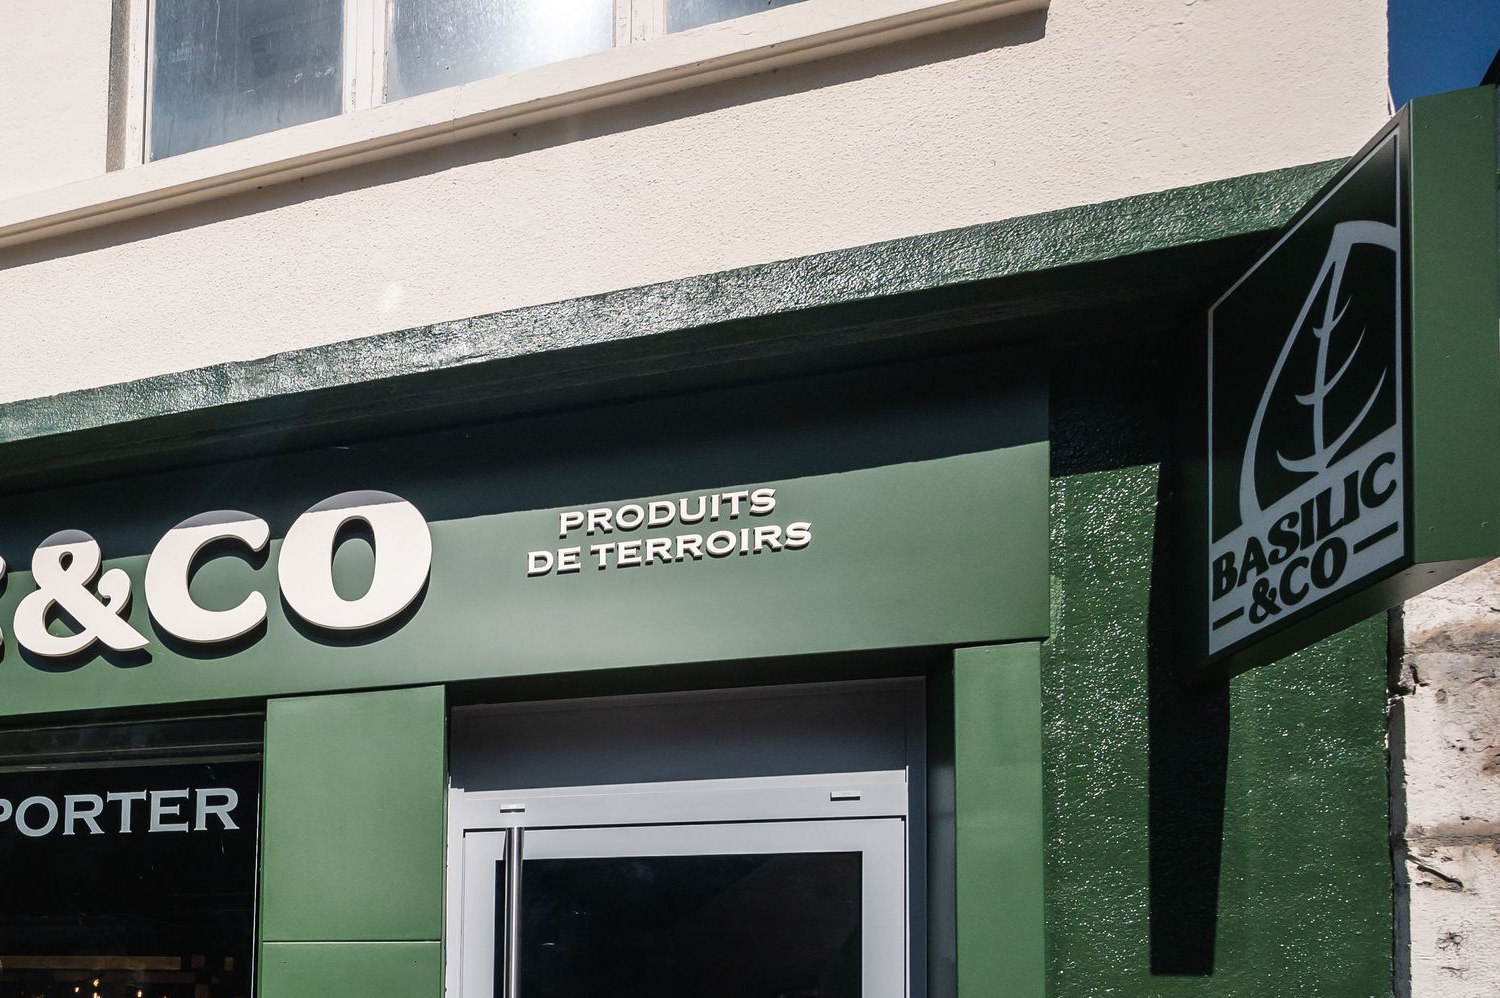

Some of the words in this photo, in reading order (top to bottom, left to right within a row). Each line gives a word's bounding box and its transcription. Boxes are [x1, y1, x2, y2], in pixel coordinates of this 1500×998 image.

[559, 488, 776, 538] PRODUITS
[1211, 451, 1397, 602] BASILIC
[527, 546, 582, 577] DE
[591, 522, 812, 570] TERROIRS
[1248, 536, 1348, 625] &CO
